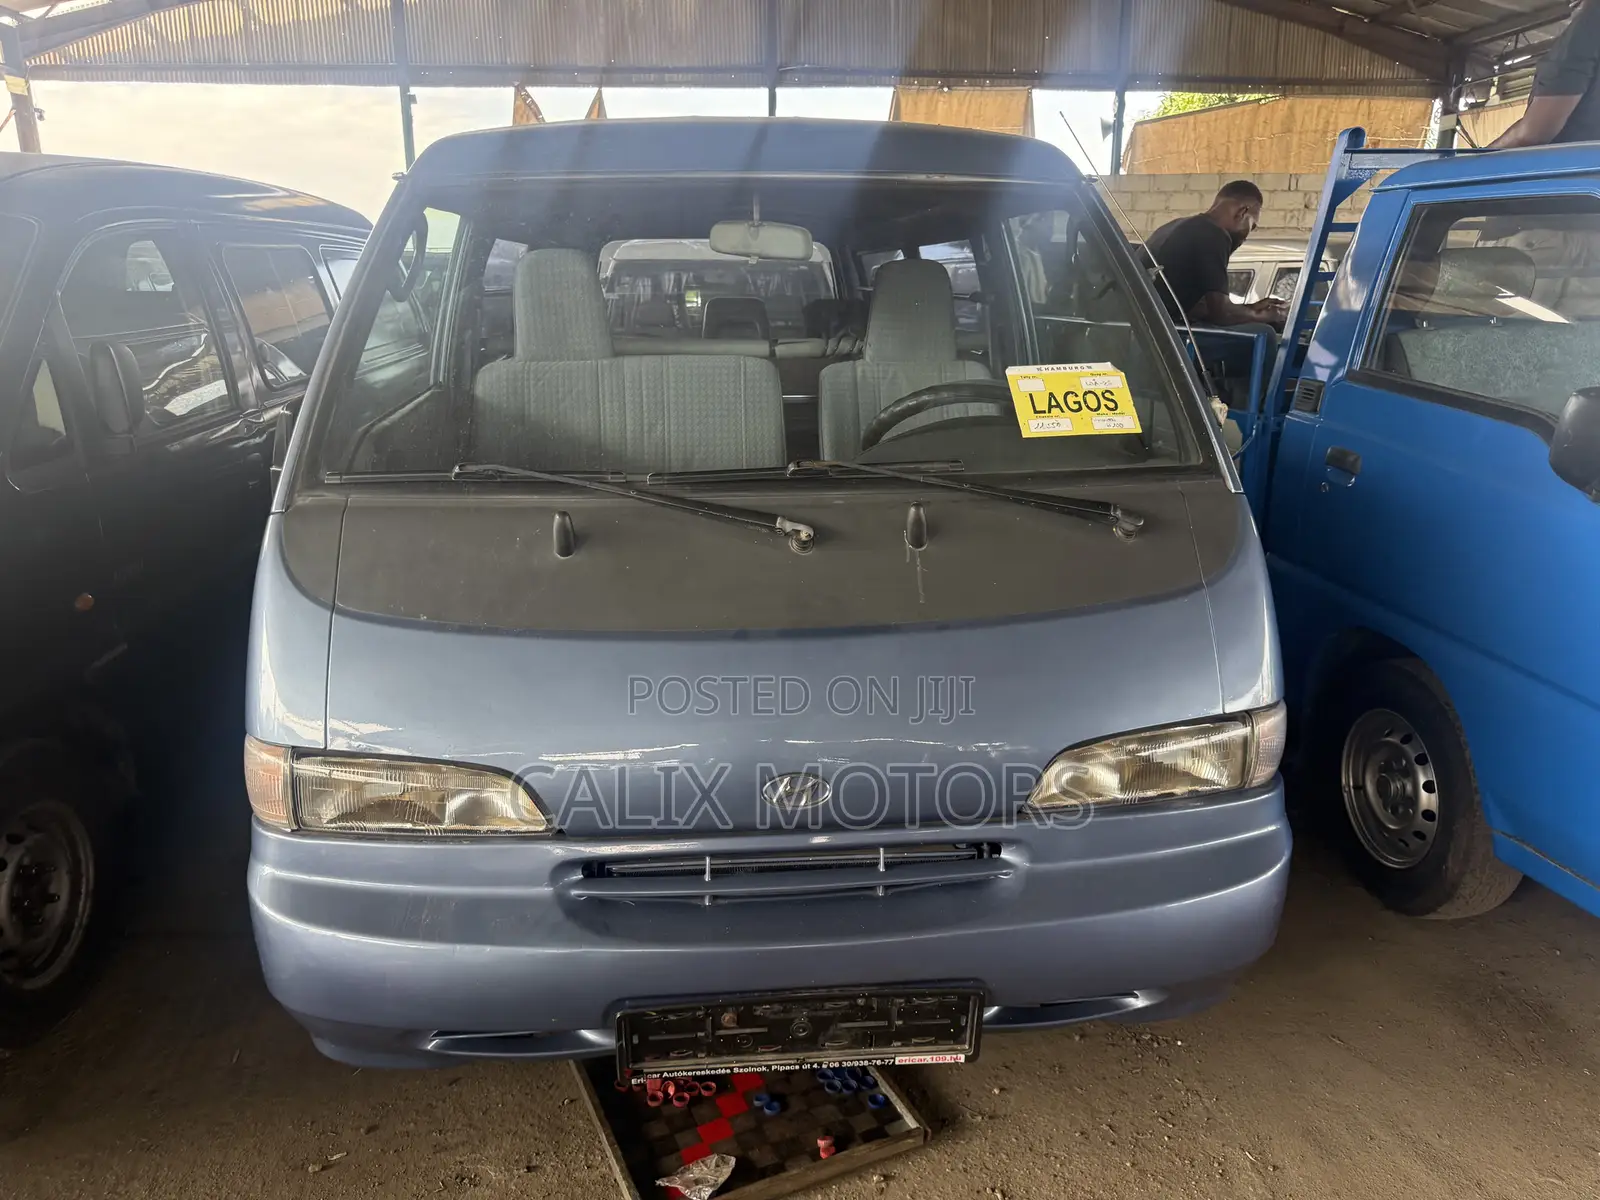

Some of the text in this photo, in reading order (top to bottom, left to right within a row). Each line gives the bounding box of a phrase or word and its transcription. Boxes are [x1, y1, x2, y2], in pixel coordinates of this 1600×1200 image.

[1029, 390, 1119, 414] LAGOS
[662, 1067, 731, 1078] Autókereskedés
[733, 1065, 769, 1074] Szolnok,
[771, 1063, 800, 1073] Pipacs
[802, 1062, 811, 1070] út
[841, 1059, 894, 1067] 30/938-76-77
[897, 1055, 962, 1064] ericar.109.hu
